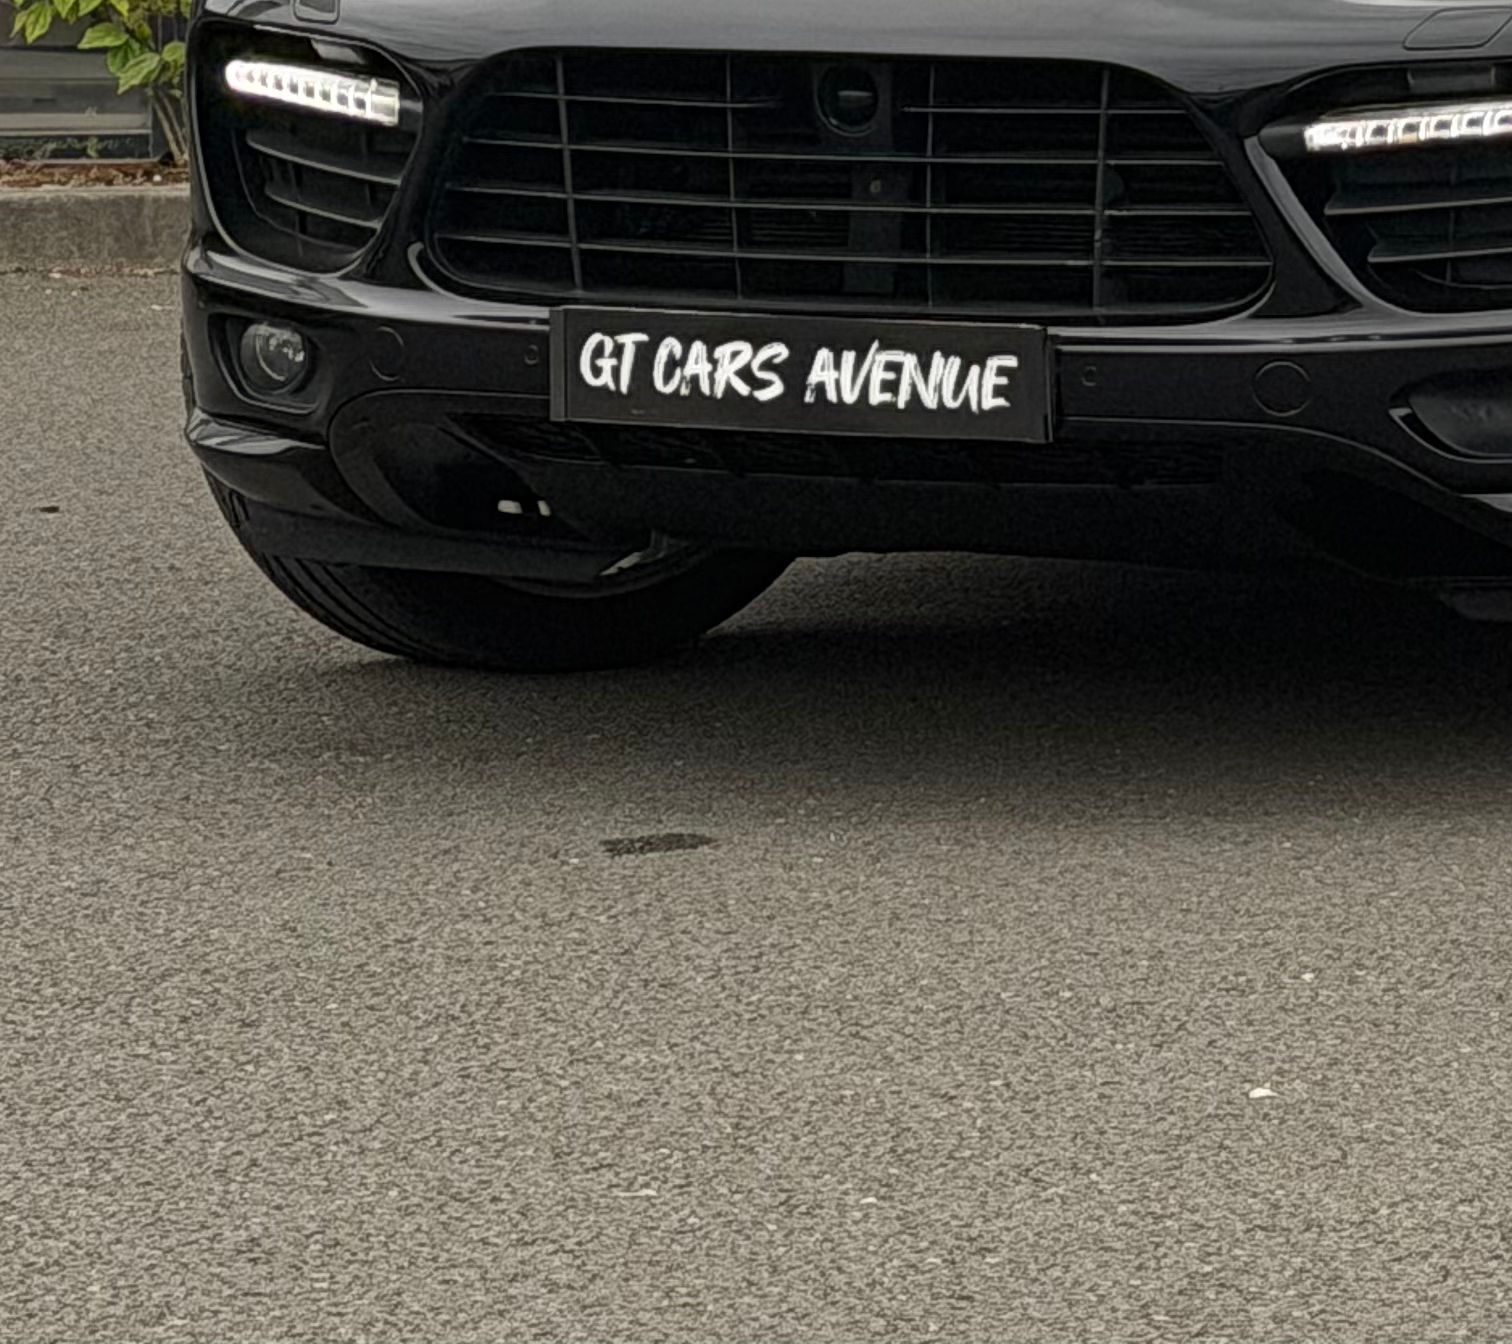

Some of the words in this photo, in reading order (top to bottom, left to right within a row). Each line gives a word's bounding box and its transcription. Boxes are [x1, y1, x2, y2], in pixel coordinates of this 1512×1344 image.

[579, 332, 649, 395] GT
[652, 336, 790, 402] CARS
[804, 340, 1019, 414] AVENUE
